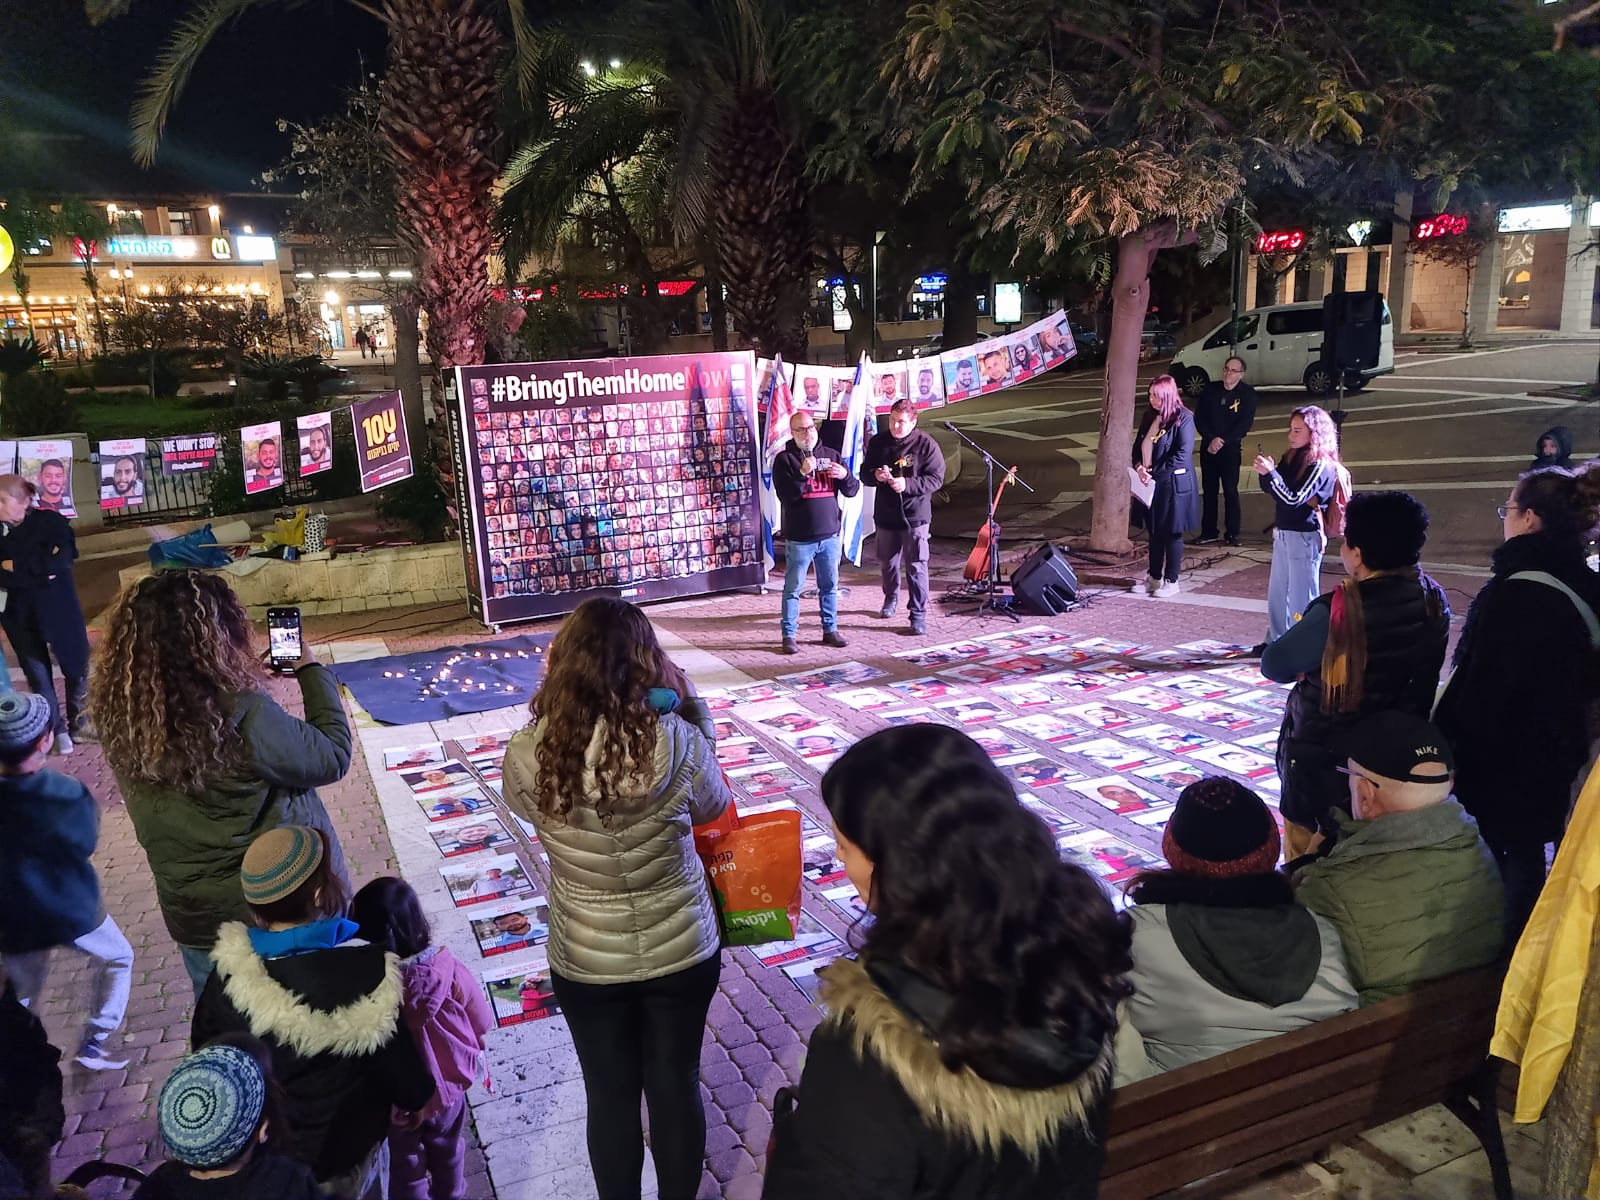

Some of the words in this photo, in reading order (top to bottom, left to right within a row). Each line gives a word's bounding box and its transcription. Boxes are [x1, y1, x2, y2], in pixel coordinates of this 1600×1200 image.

[163, 440, 177, 452] WE
[176, 438, 198, 451] WON'T
[199, 437, 215, 449] STOP
[1415, 745, 1439, 757] NIKE
[731, 911, 778, 926] ויקטורי
